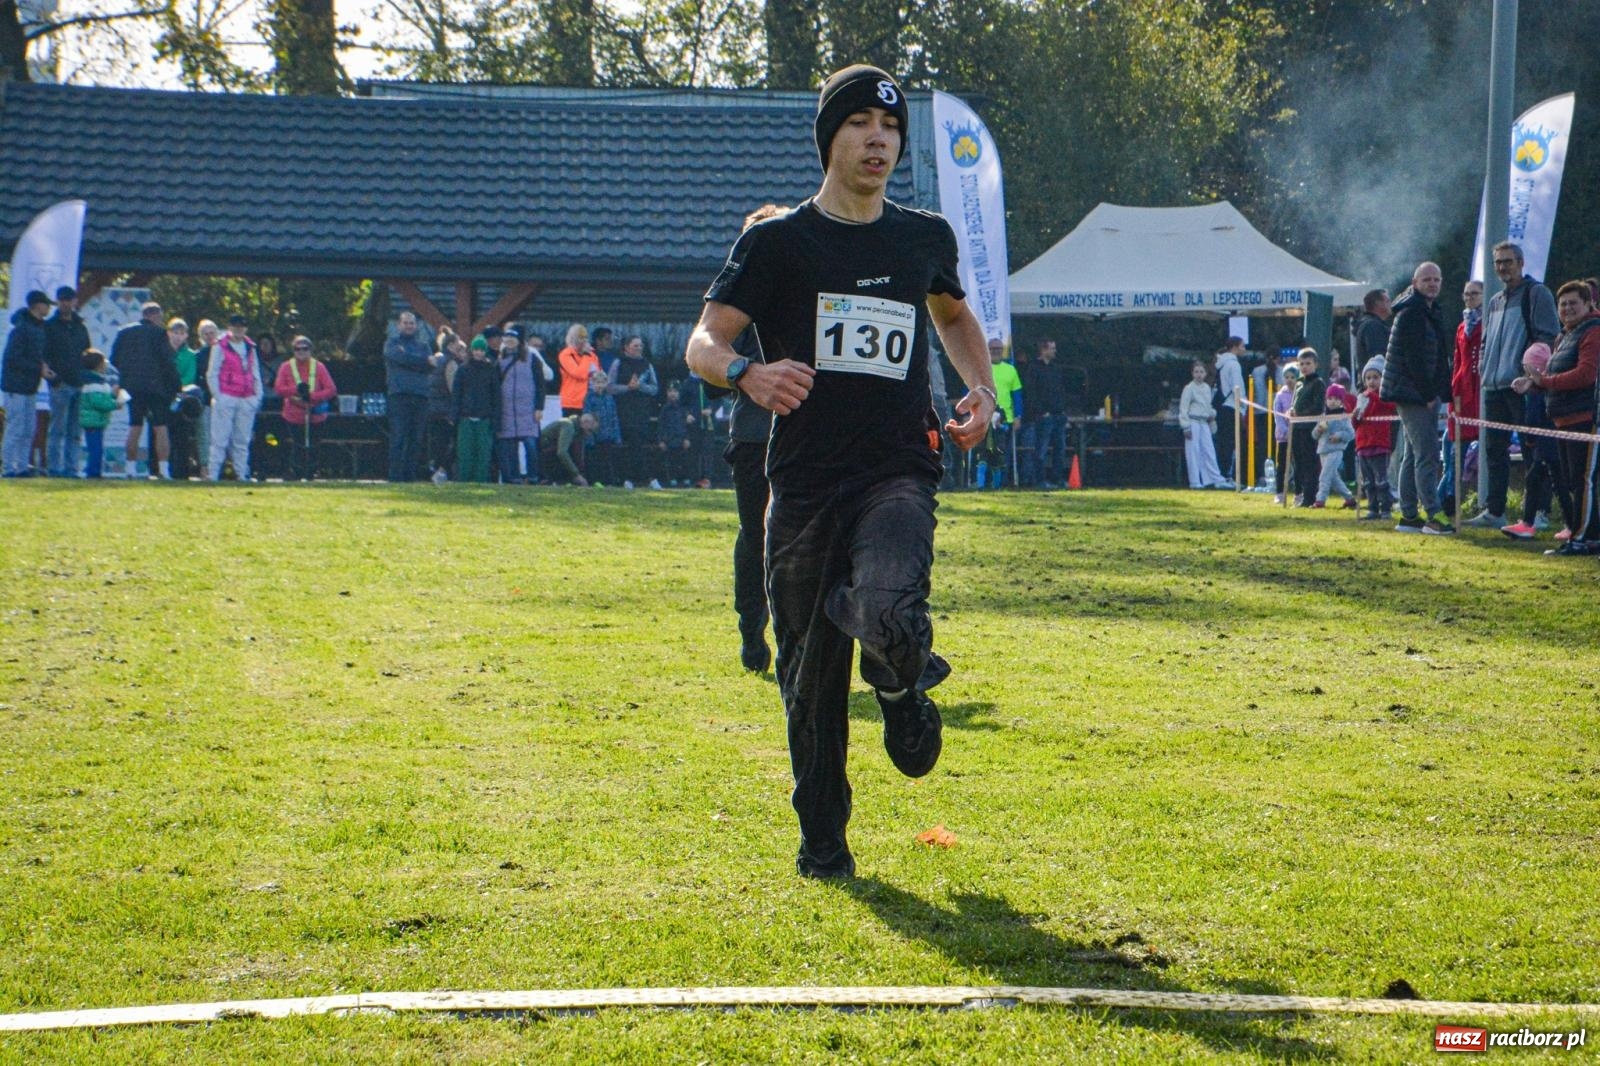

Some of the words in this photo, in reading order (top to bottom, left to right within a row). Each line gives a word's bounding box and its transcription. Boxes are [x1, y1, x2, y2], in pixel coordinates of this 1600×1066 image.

[974, 270, 994, 287] DLA
[1039, 293, 1123, 308] STOWARZYSZENIE
[1133, 292, 1176, 306] AKTYWNI
[1184, 292, 1203, 305] DLA
[1213, 291, 1262, 305] LEPSZEGO
[1271, 290, 1302, 304] JUTRA
[824, 322, 908, 365] 130
